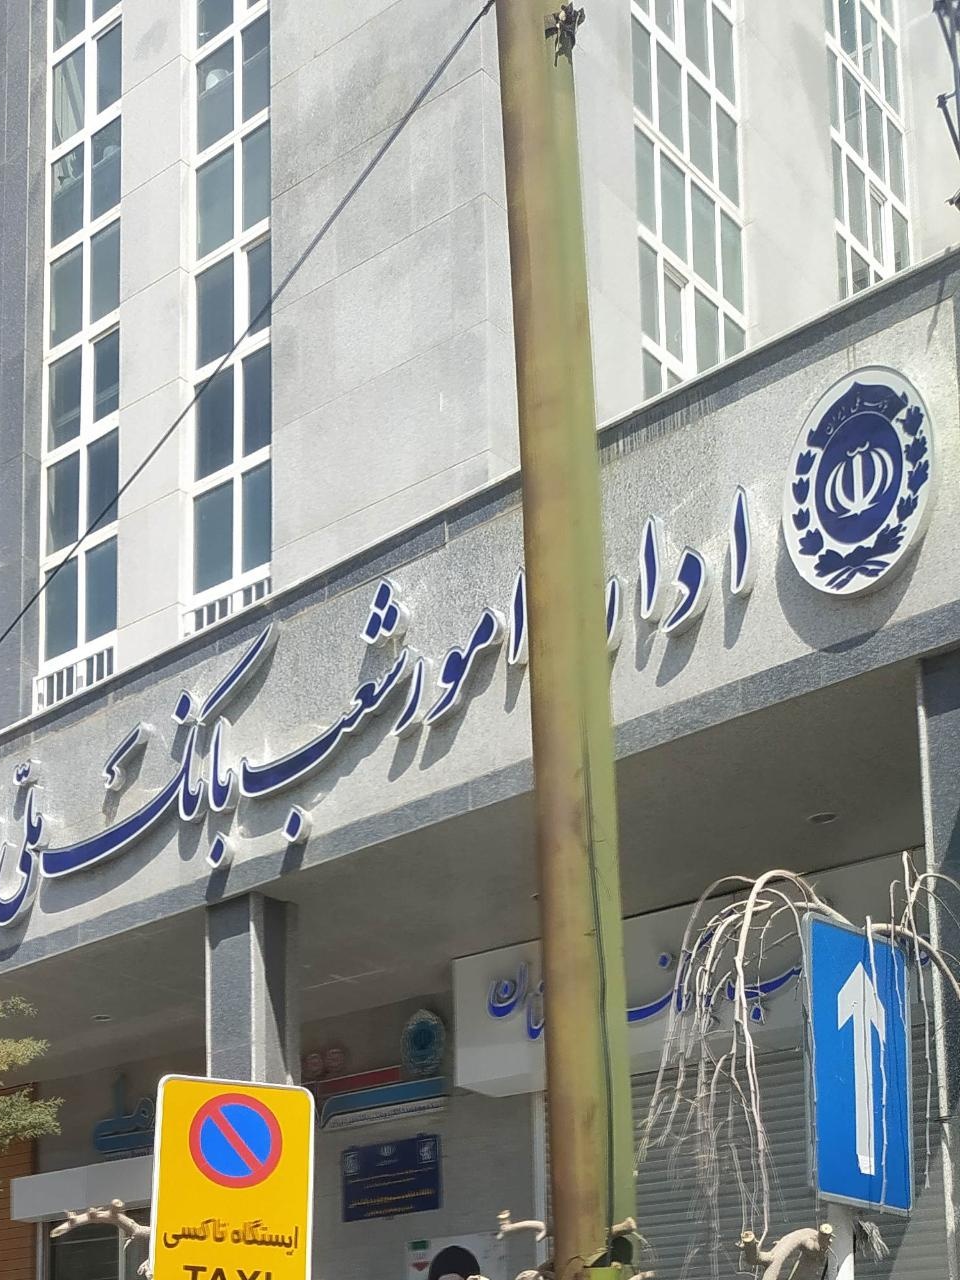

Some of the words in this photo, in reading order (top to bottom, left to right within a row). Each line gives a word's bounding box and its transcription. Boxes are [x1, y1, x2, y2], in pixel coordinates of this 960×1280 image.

[240, 576, 415, 843] شعب
[392, 566, 527, 738] امور
[40, 622, 280, 878] بانک
[163, 1219, 228, 1249] تاکسی
[231, 1219, 299, 1256] ایستگاه
